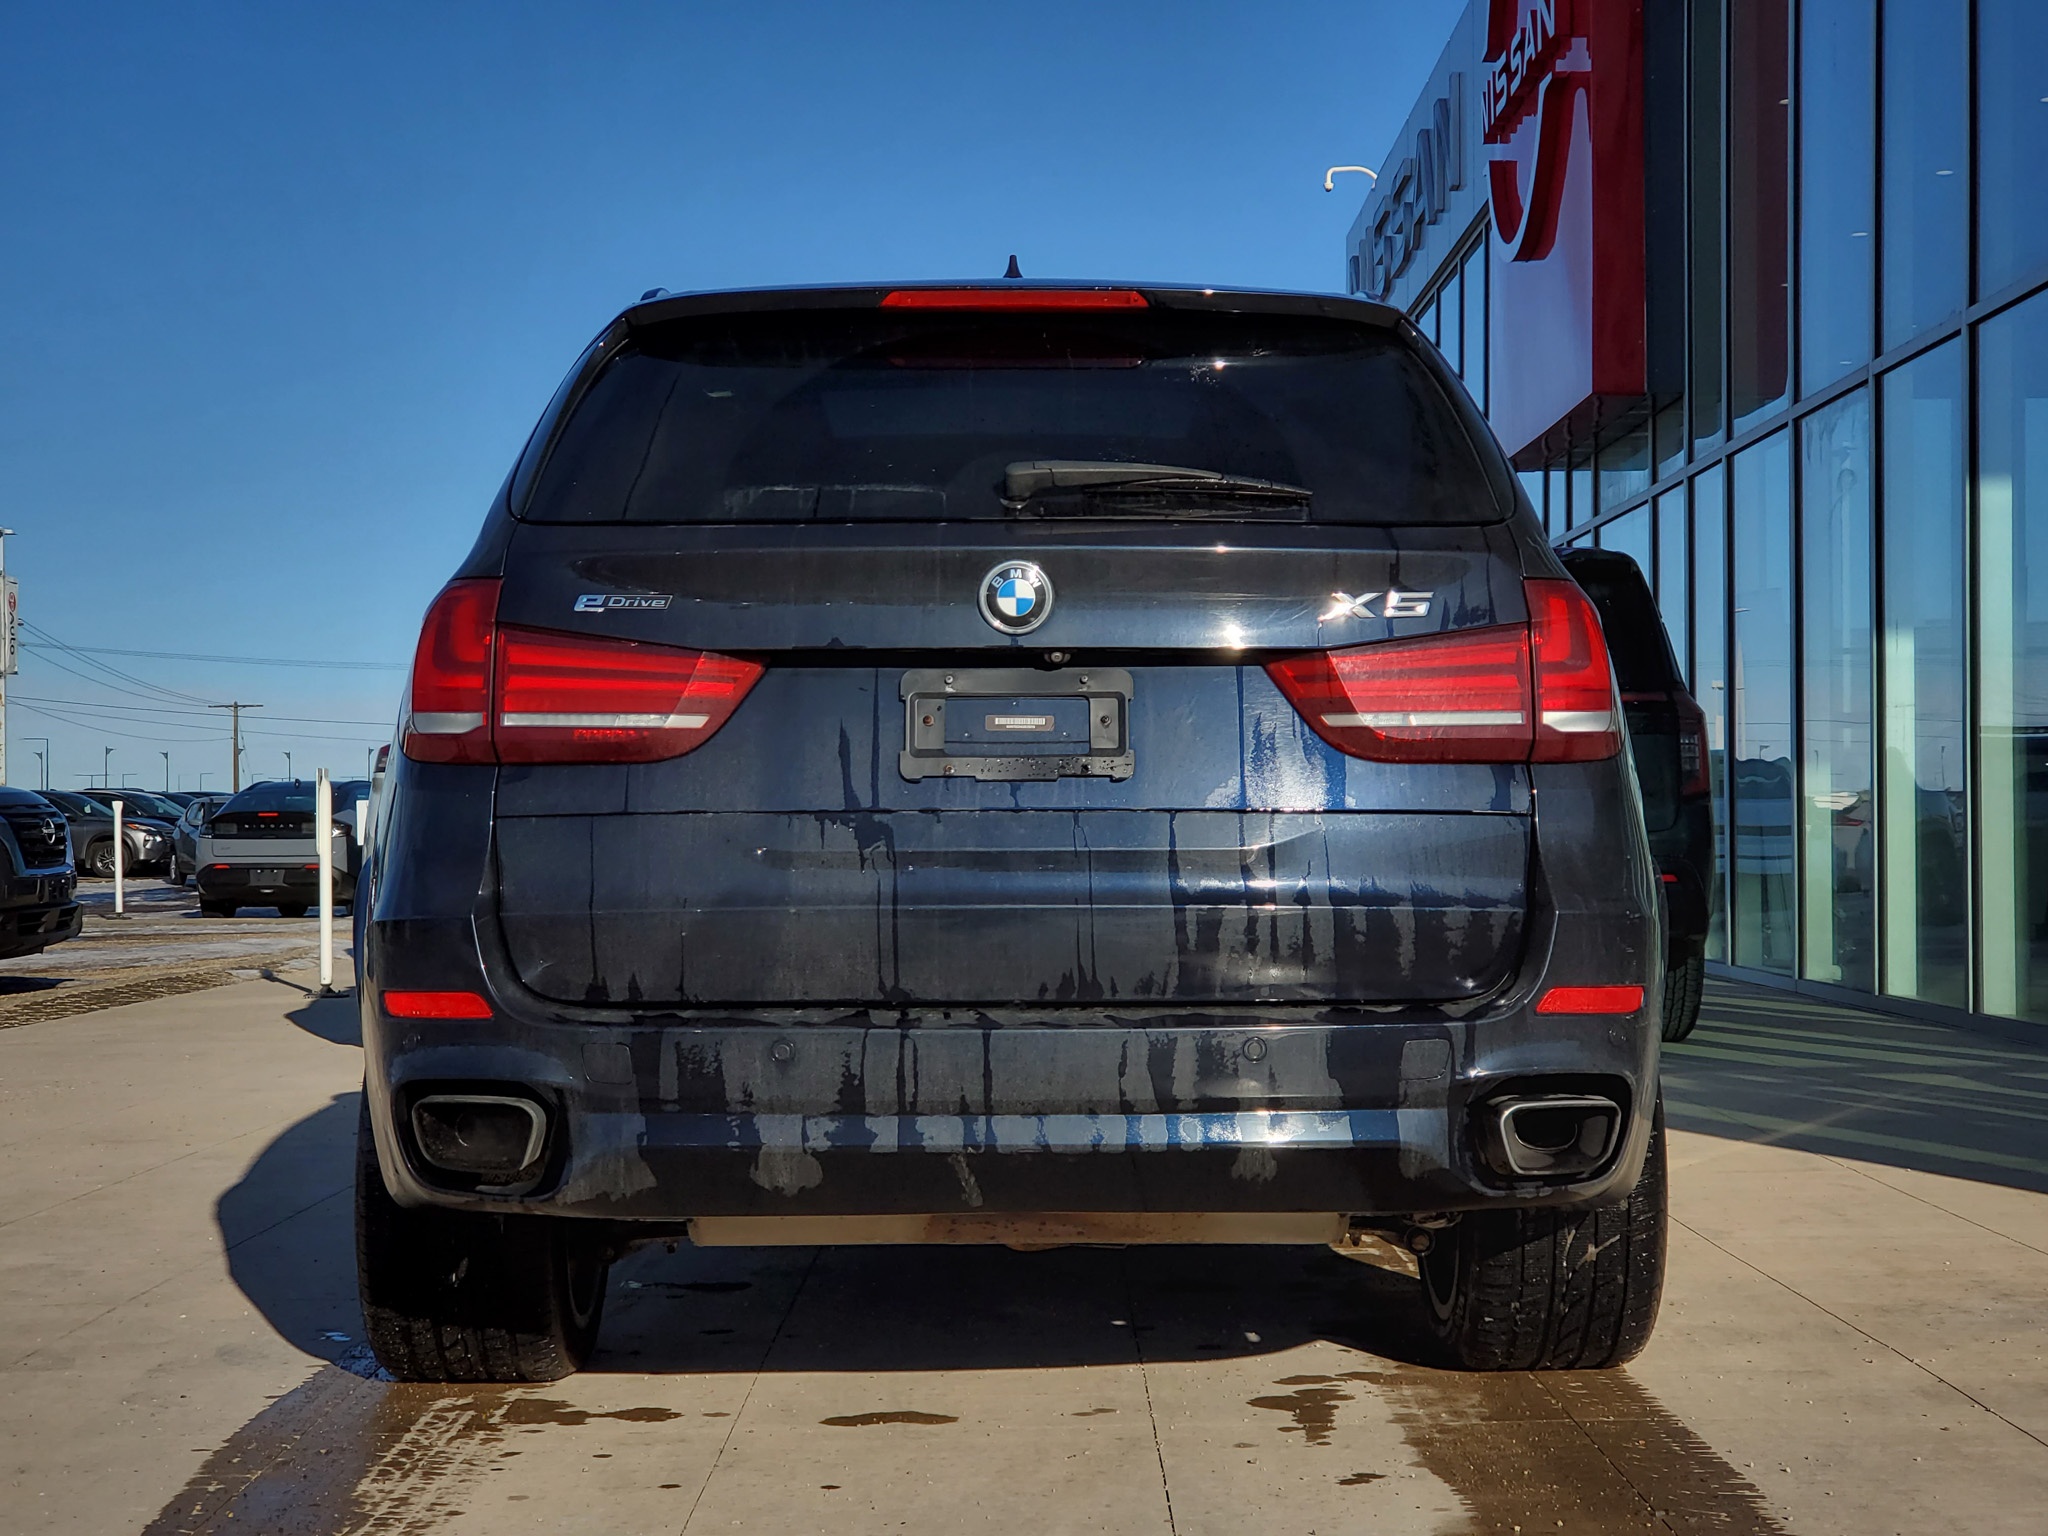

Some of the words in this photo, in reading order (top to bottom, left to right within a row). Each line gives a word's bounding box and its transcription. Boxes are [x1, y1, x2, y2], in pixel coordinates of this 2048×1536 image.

[1481, 0, 1555, 145] NISSAN
[1349, 71, 1465, 303] NISSAN
[991, 568, 1042, 588] BMW
[1317, 591, 1435, 621] X5
